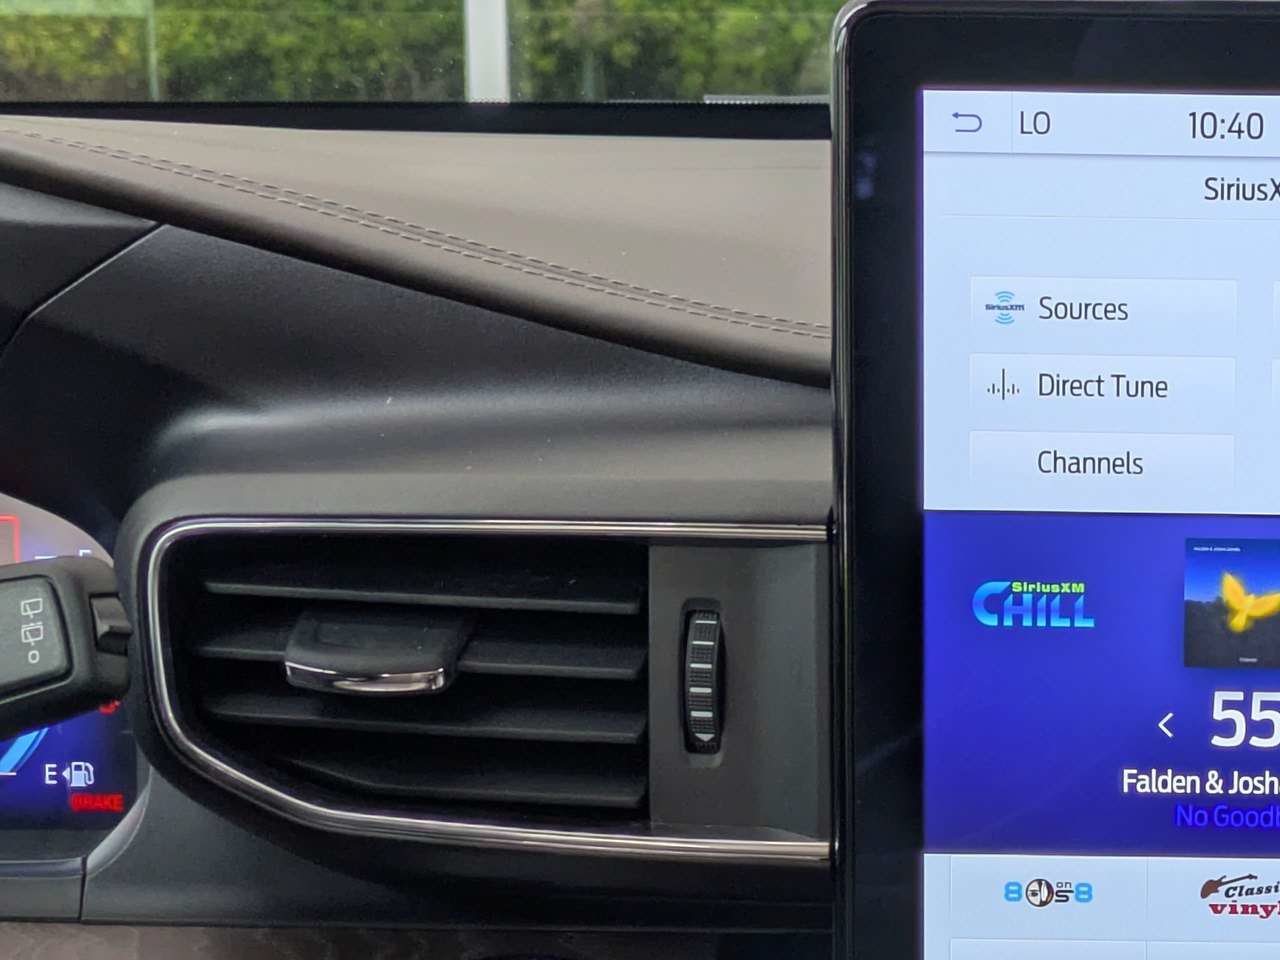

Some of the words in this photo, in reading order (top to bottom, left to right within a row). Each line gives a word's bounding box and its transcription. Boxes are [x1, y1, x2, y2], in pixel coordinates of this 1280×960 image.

[1021, 111, 1050, 134] LO
[1189, 112, 1263, 139] 10:40
[1039, 297, 1128, 320] Sources
[1039, 374, 1104, 396] Direct
[1111, 375, 1167, 397] Tune
[1038, 450, 1143, 474] Channels
[1012, 582, 1084, 593] SiriusXM
[972, 581, 1095, 627] CHILL
[45, 764, 57, 784] E
[1124, 769, 1200, 793] Falden
[1206, 770, 1223, 793] &
[1176, 805, 1208, 827] No
